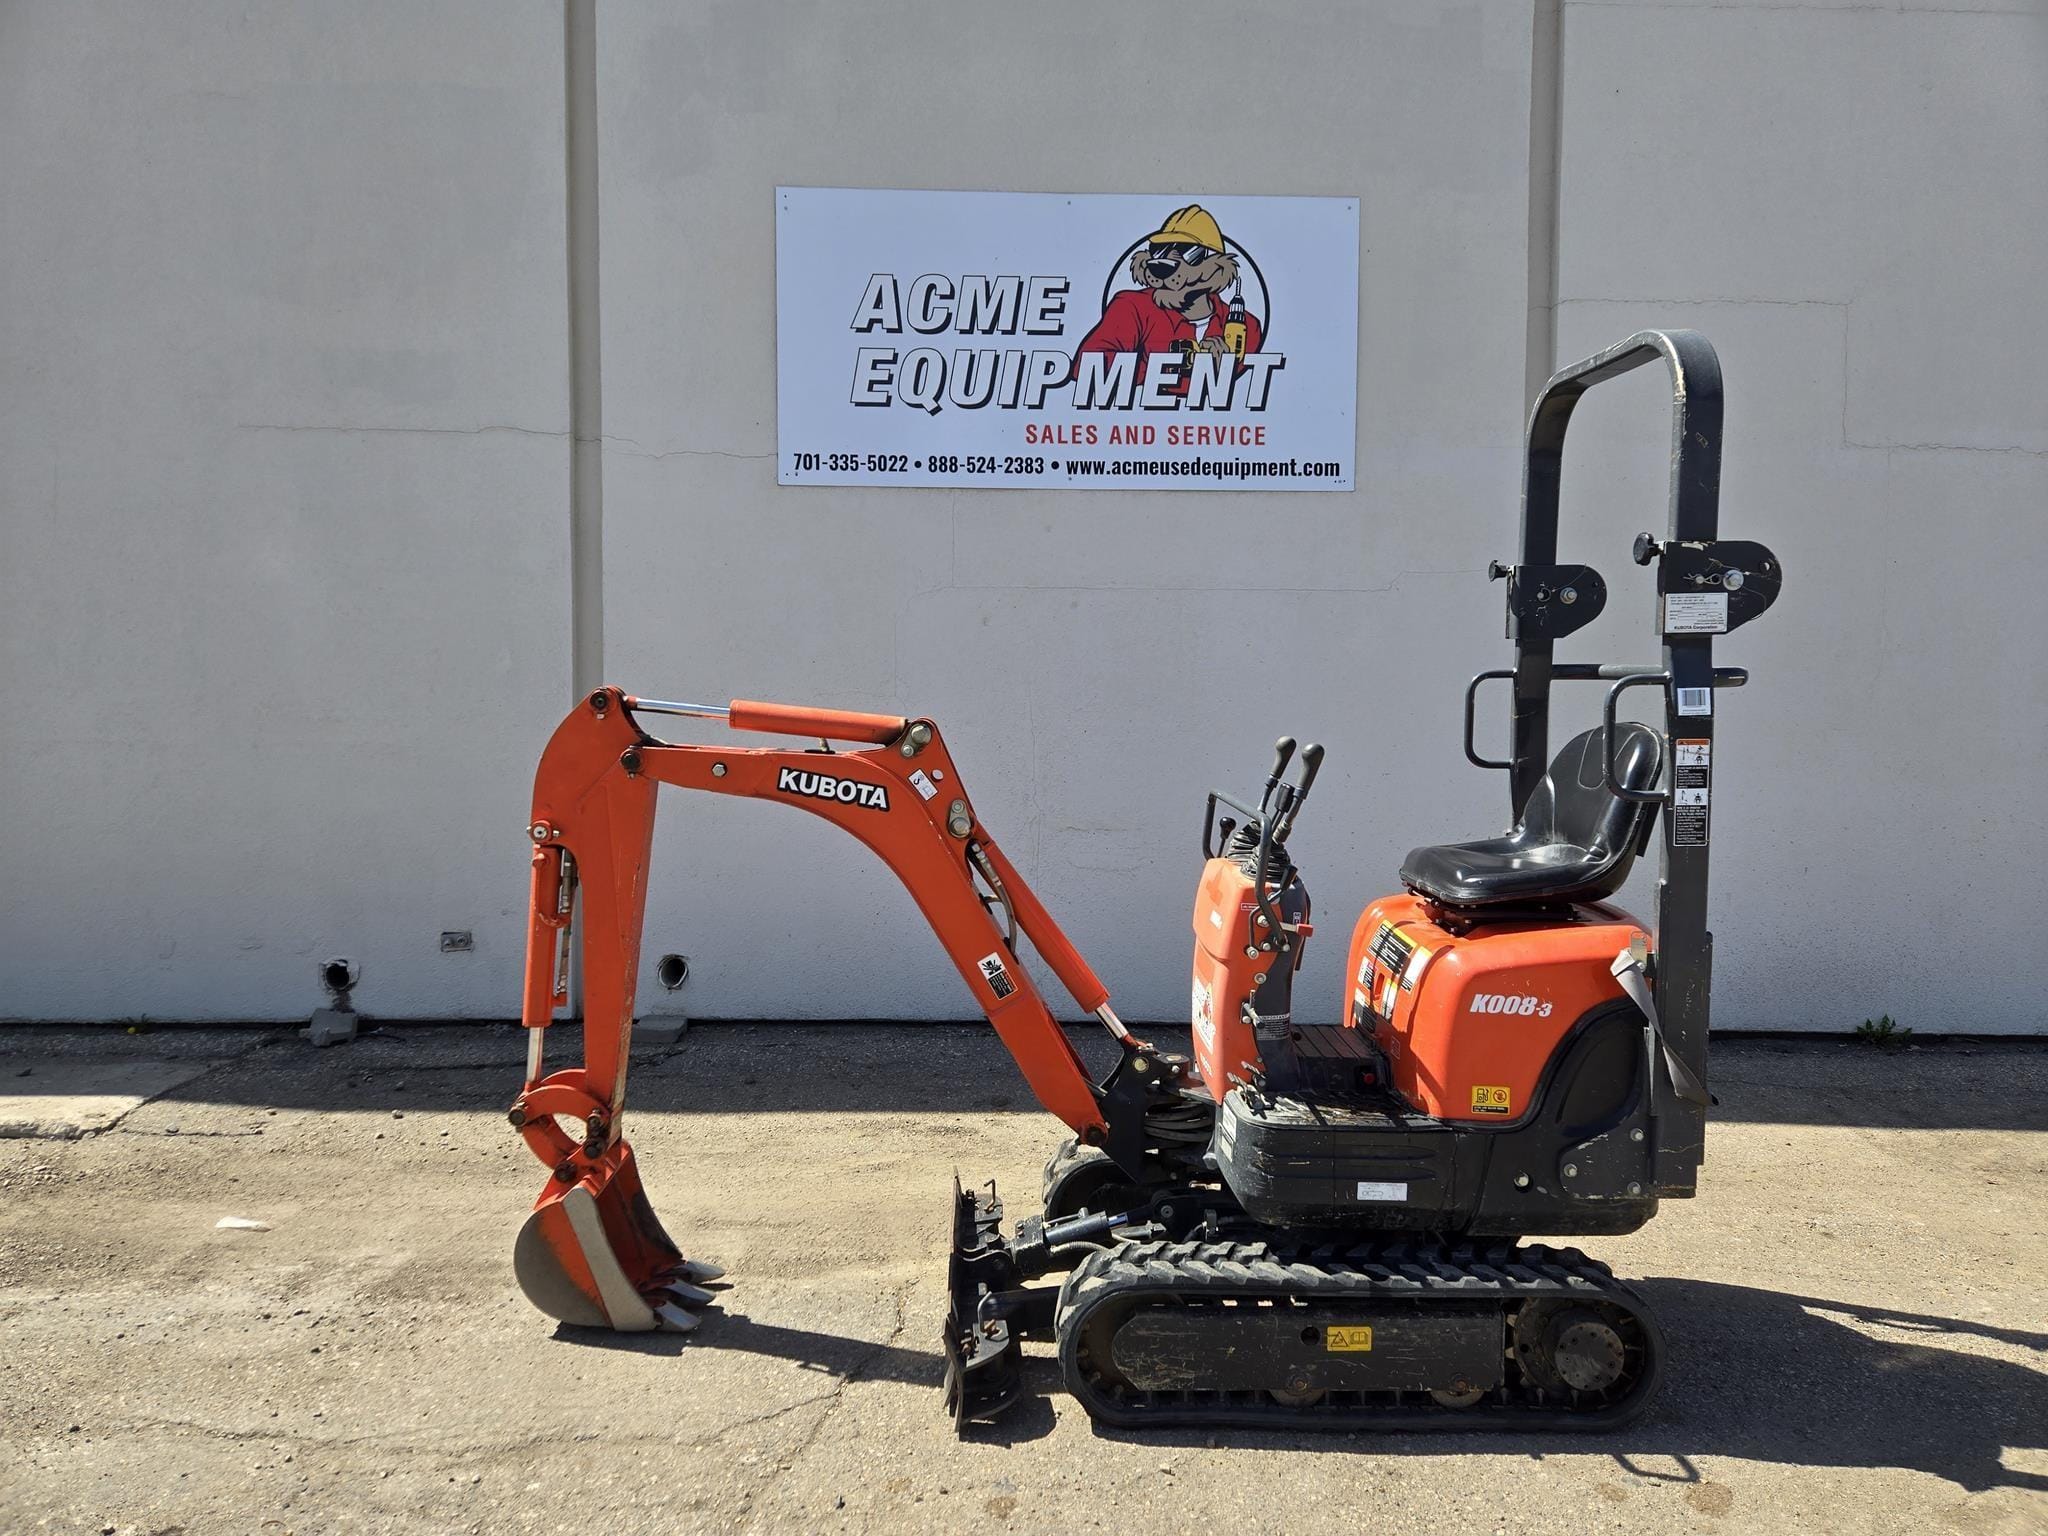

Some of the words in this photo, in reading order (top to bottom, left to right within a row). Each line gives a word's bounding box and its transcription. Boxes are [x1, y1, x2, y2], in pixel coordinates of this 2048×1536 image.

[850, 273, 1070, 336] ACME
[850, 347, 1286, 416] EQUIPMENT
[1025, 424, 1098, 445] SALES
[1109, 425, 1156, 445] AND
[1167, 426, 1266, 446] SERVICE
[793, 453, 908, 473] 701-335-5022
[928, 456, 1044, 474] 888-524-2383
[1066, 457, 1340, 480] www.acmeusedequipment.com
[778, 768, 888, 809] KUBOTA
[1469, 993, 1553, 1017] K008-3
